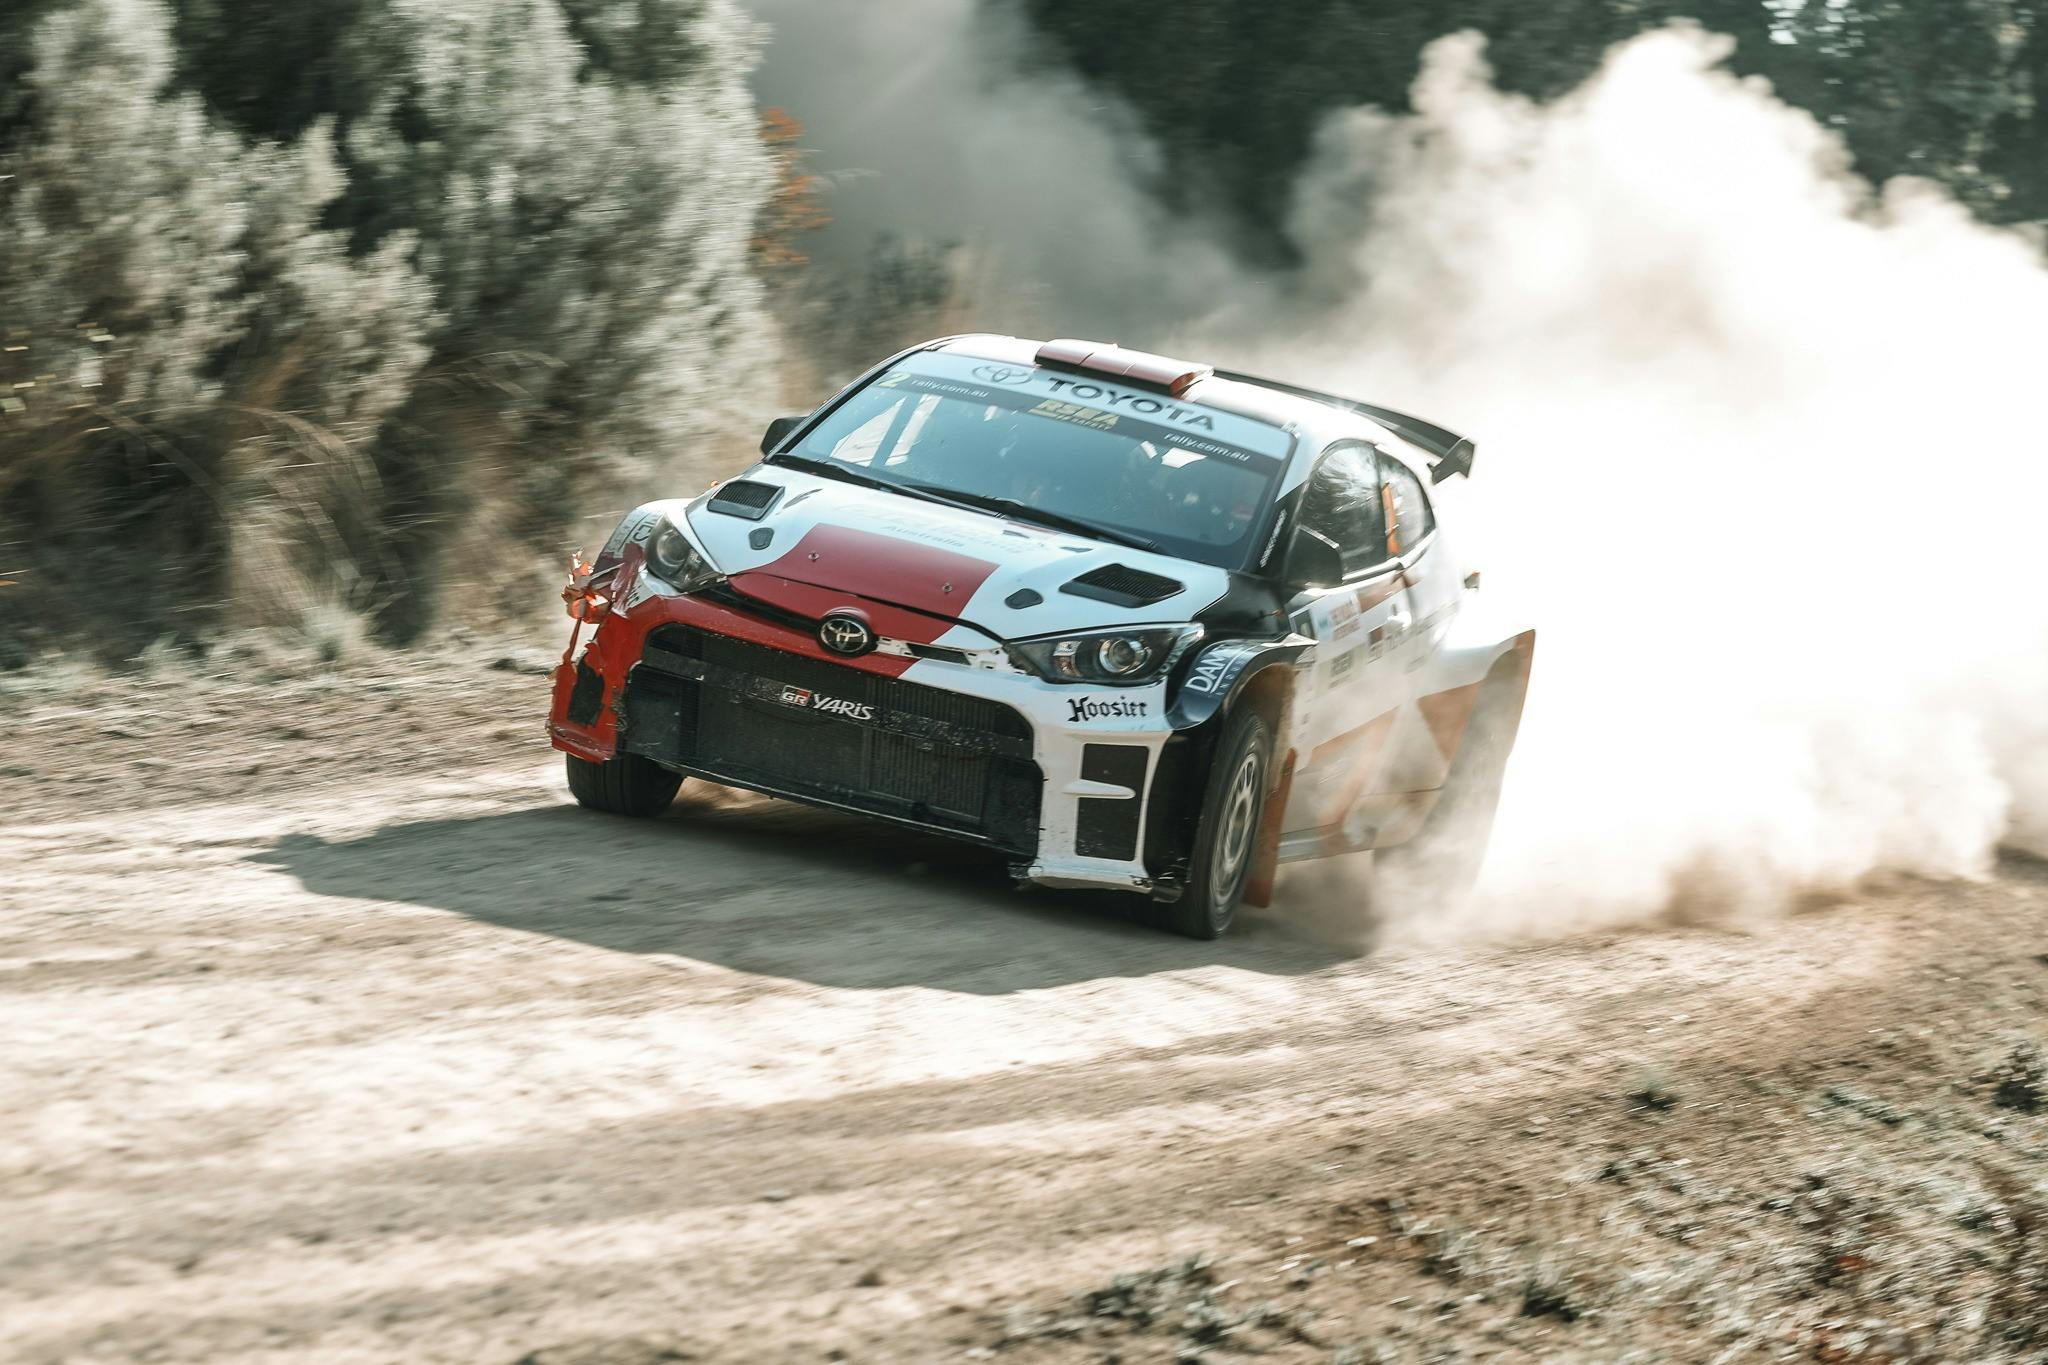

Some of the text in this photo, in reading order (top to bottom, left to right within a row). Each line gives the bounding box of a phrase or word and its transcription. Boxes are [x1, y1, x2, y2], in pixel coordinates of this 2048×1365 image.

[911, 379, 990, 398] rally.com.au
[1048, 377, 1214, 431] TOYOTA
[1164, 433, 1250, 462] rally.com.au
[881, 525, 965, 546] Australia
[782, 691, 808, 706] GR
[1067, 695, 1148, 722] Hoosier
